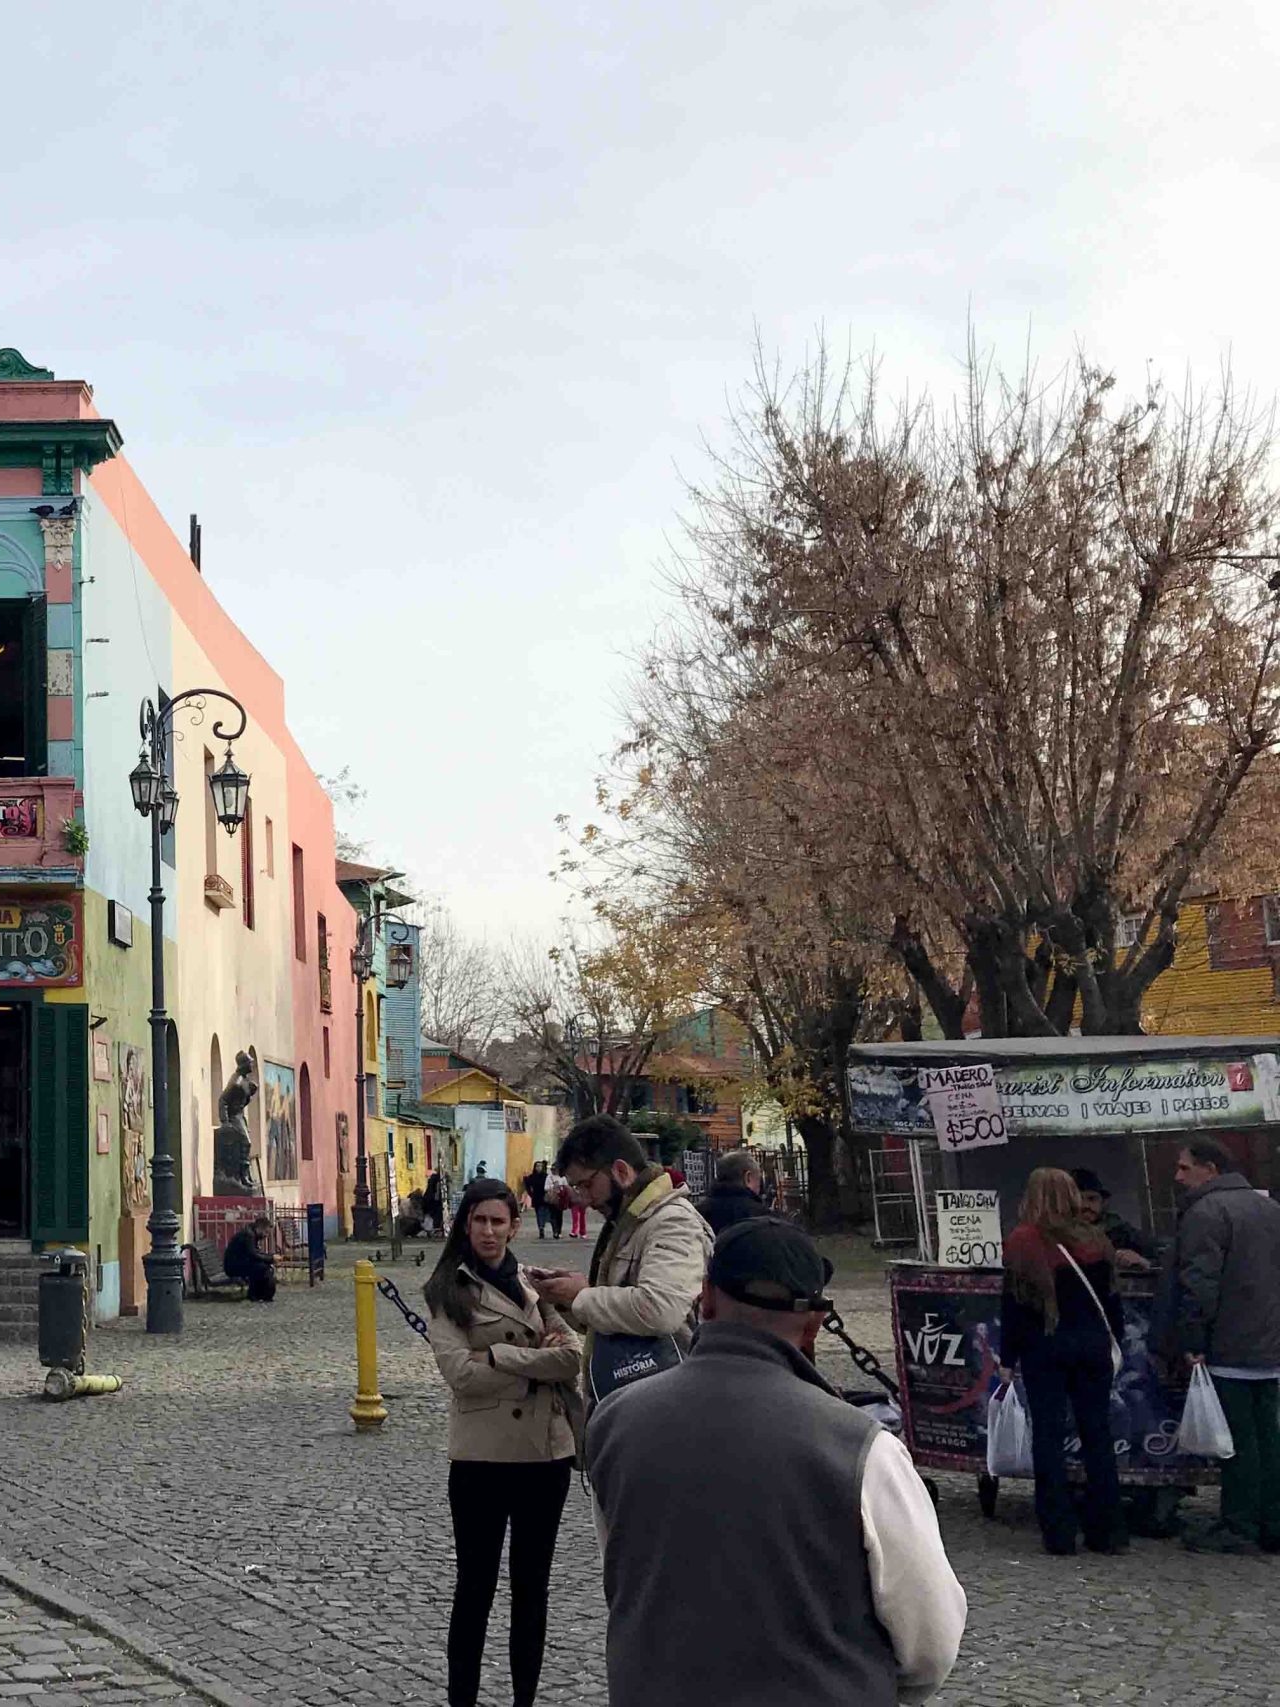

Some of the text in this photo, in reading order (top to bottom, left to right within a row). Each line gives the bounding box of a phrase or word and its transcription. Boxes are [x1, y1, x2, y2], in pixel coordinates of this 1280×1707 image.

[925, 1067, 988, 1088] MADERO
[996, 1076, 1065, 1096] ourist
[1070, 1064, 1226, 1102] Information
[1002, 1104, 1069, 1118] SERVAS
[1093, 1100, 1152, 1118] VIAJES
[1173, 1096, 1229, 1112] PASEOS
[946, 1114, 1004, 1147] $500
[938, 1192, 975, 1210] TANGO
[950, 1215, 982, 1226] CENA
[945, 1241, 998, 1266] $900
